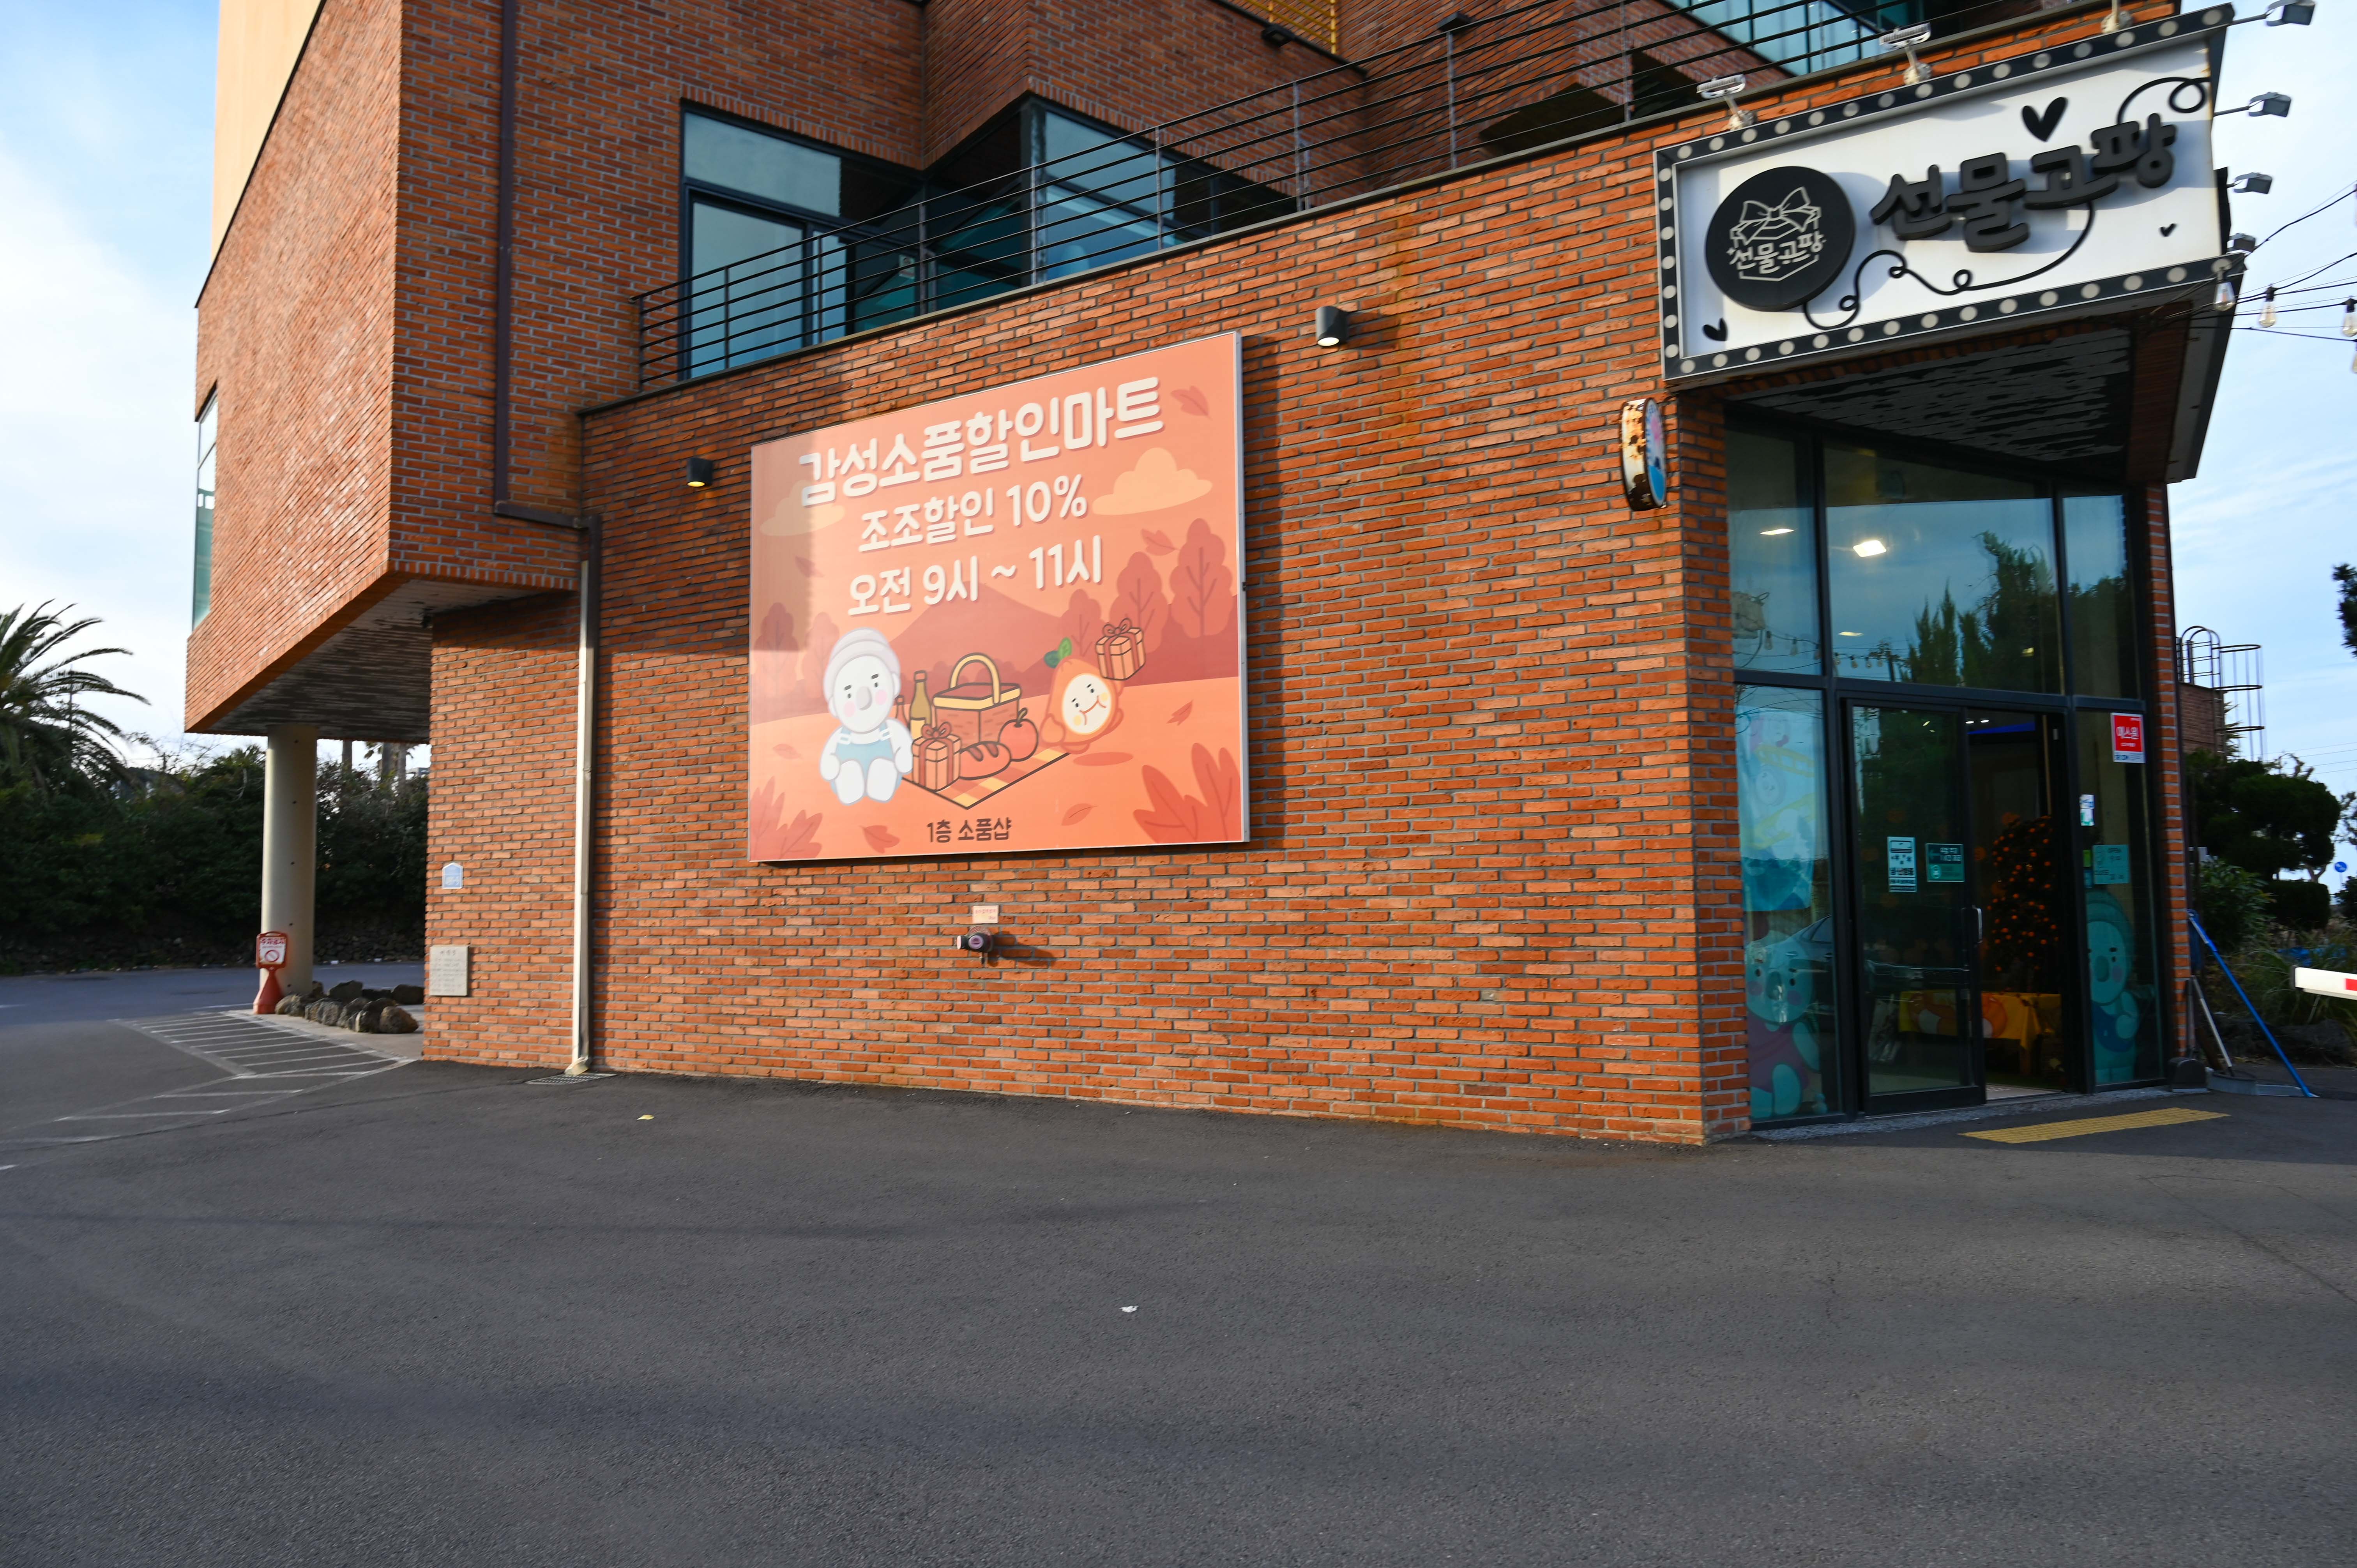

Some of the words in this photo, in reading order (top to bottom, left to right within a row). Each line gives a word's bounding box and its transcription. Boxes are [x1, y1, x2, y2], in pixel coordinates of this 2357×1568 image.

[1870, 113, 2177, 253] 선물고팡
[1729, 231, 1825, 274] 선물고팡
[799, 376, 1164, 507] 감성소품할인마트
[858, 487, 995, 553] 조조할인
[1006, 473, 1088, 527] 10%
[848, 567, 911, 616] 오전
[922, 555, 979, 606] 9시
[1028, 535, 1103, 590] 11시
[927, 819, 952, 843] 1층
[958, 817, 1012, 841] 소품샵
